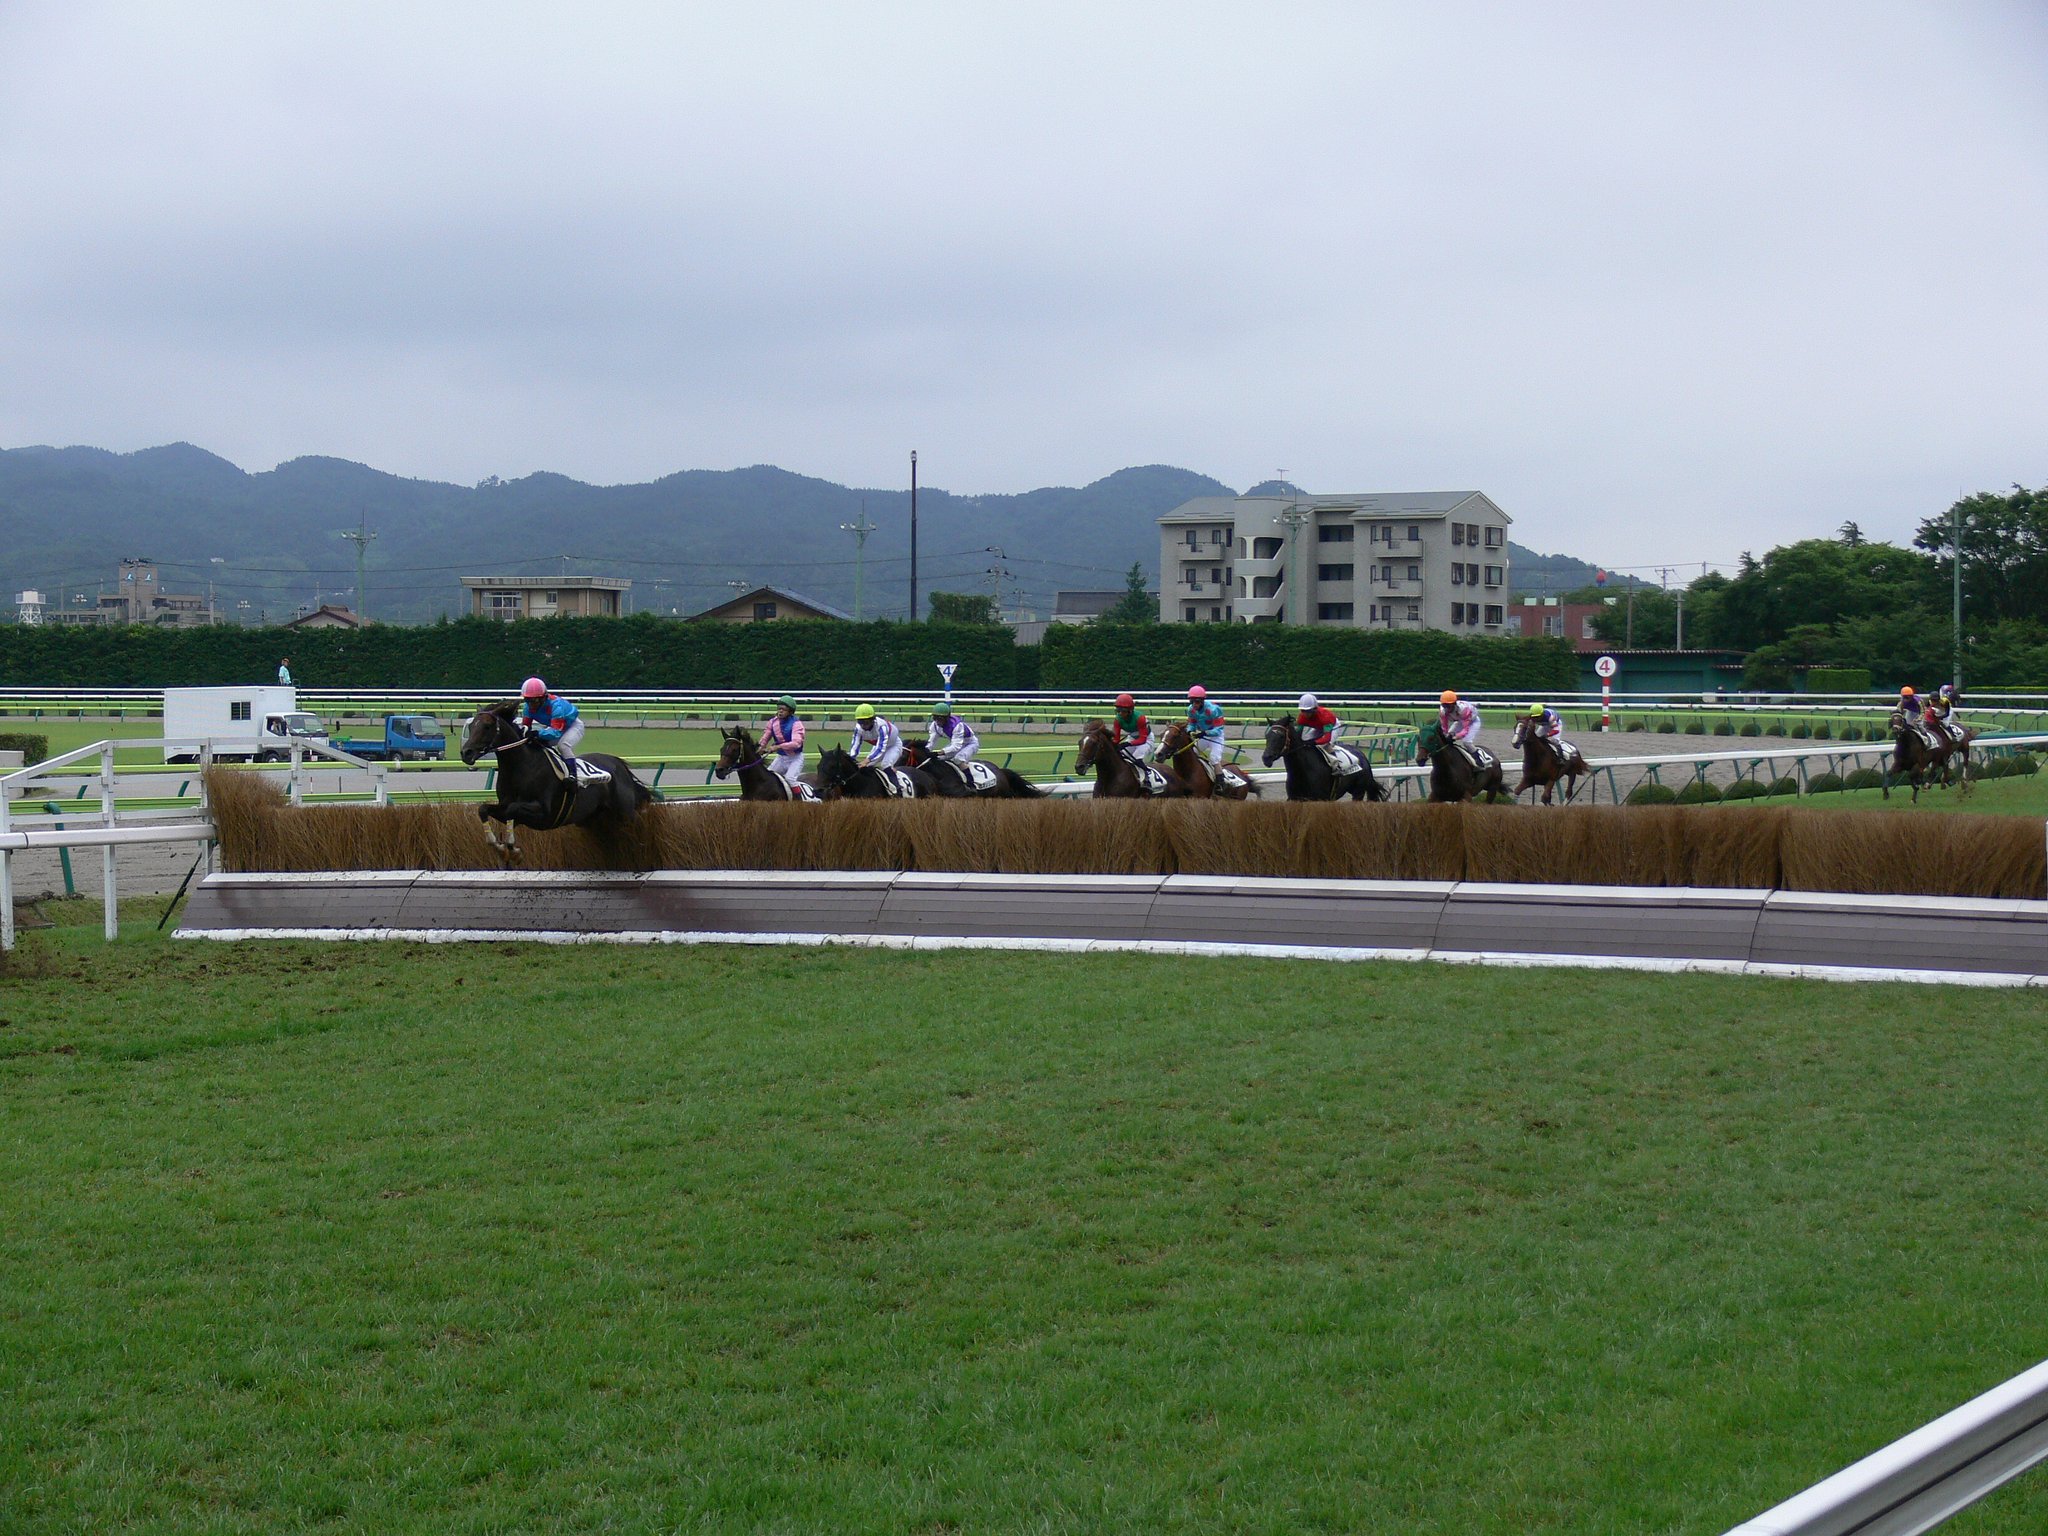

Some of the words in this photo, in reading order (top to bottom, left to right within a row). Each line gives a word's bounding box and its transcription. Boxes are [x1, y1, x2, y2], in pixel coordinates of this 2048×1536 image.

[943, 665, 952, 677] 4
[1599, 659, 1611, 673] 4
[576, 761, 603, 777] 14
[973, 764, 989, 779] 9
[799, 783, 815, 801] 10
